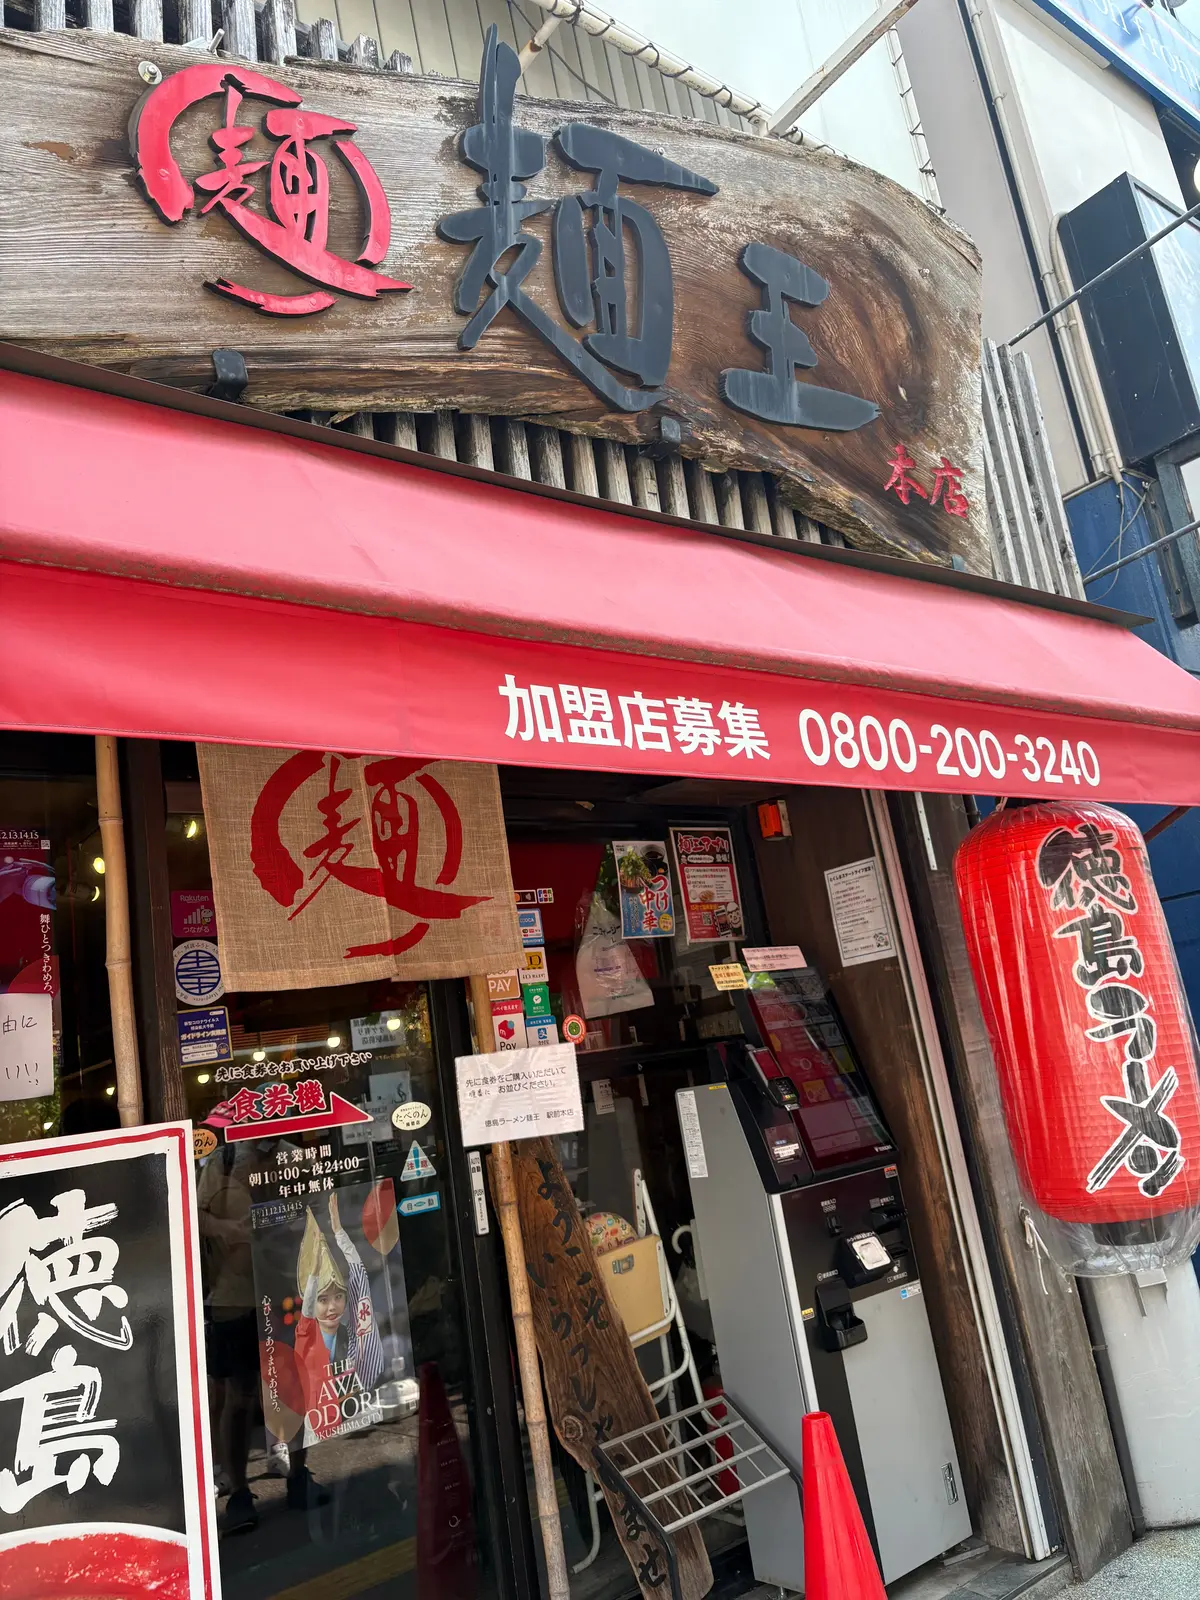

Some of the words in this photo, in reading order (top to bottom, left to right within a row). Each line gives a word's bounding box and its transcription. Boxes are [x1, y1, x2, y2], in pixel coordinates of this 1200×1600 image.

[436, 22, 882, 431] 麺王
[883, 445, 968, 518] 本店
[498, 674, 771, 761] 加盟店募集
[798, 708, 1101, 788] 0800-200-3240
[179, 894, 209, 902] Rakuten
[638, 885, 658, 933] 中華
[651, 875, 669, 912] つけ
[182, 926, 210, 934] つながる
[488, 979, 512, 993] PAY
[1036, 822, 1186, 1198] 徳島ラーメン
[215, 1051, 373, 1083] 先に食券をお買い上げ下さい
[465, 1066, 567, 1088] 先に食券をご購入いただいて
[229, 1079, 327, 1122] 食券機
[498, 1080, 556, 1094] お並びください。
[395, 1108, 429, 1124] たべのん
[195, 1136, 213, 1147] のん
[276, 1144, 332, 1165] 営業時間
[279, 1177, 335, 1199] 年中無休
[537, 1159, 609, 1330] ようこそ
[0, 1188, 133, 1513] 徳島
[260, 1294, 281, 1413] 心ひとつあつまれ、あほう。
[323, 1358, 356, 1377] THE
[318, 1371, 365, 1404] AWA
[304, 1387, 384, 1431] ODORI
[308, 1419, 362, 1445] TOKUSHIMA
[361, 1411, 383, 1428] CITY
